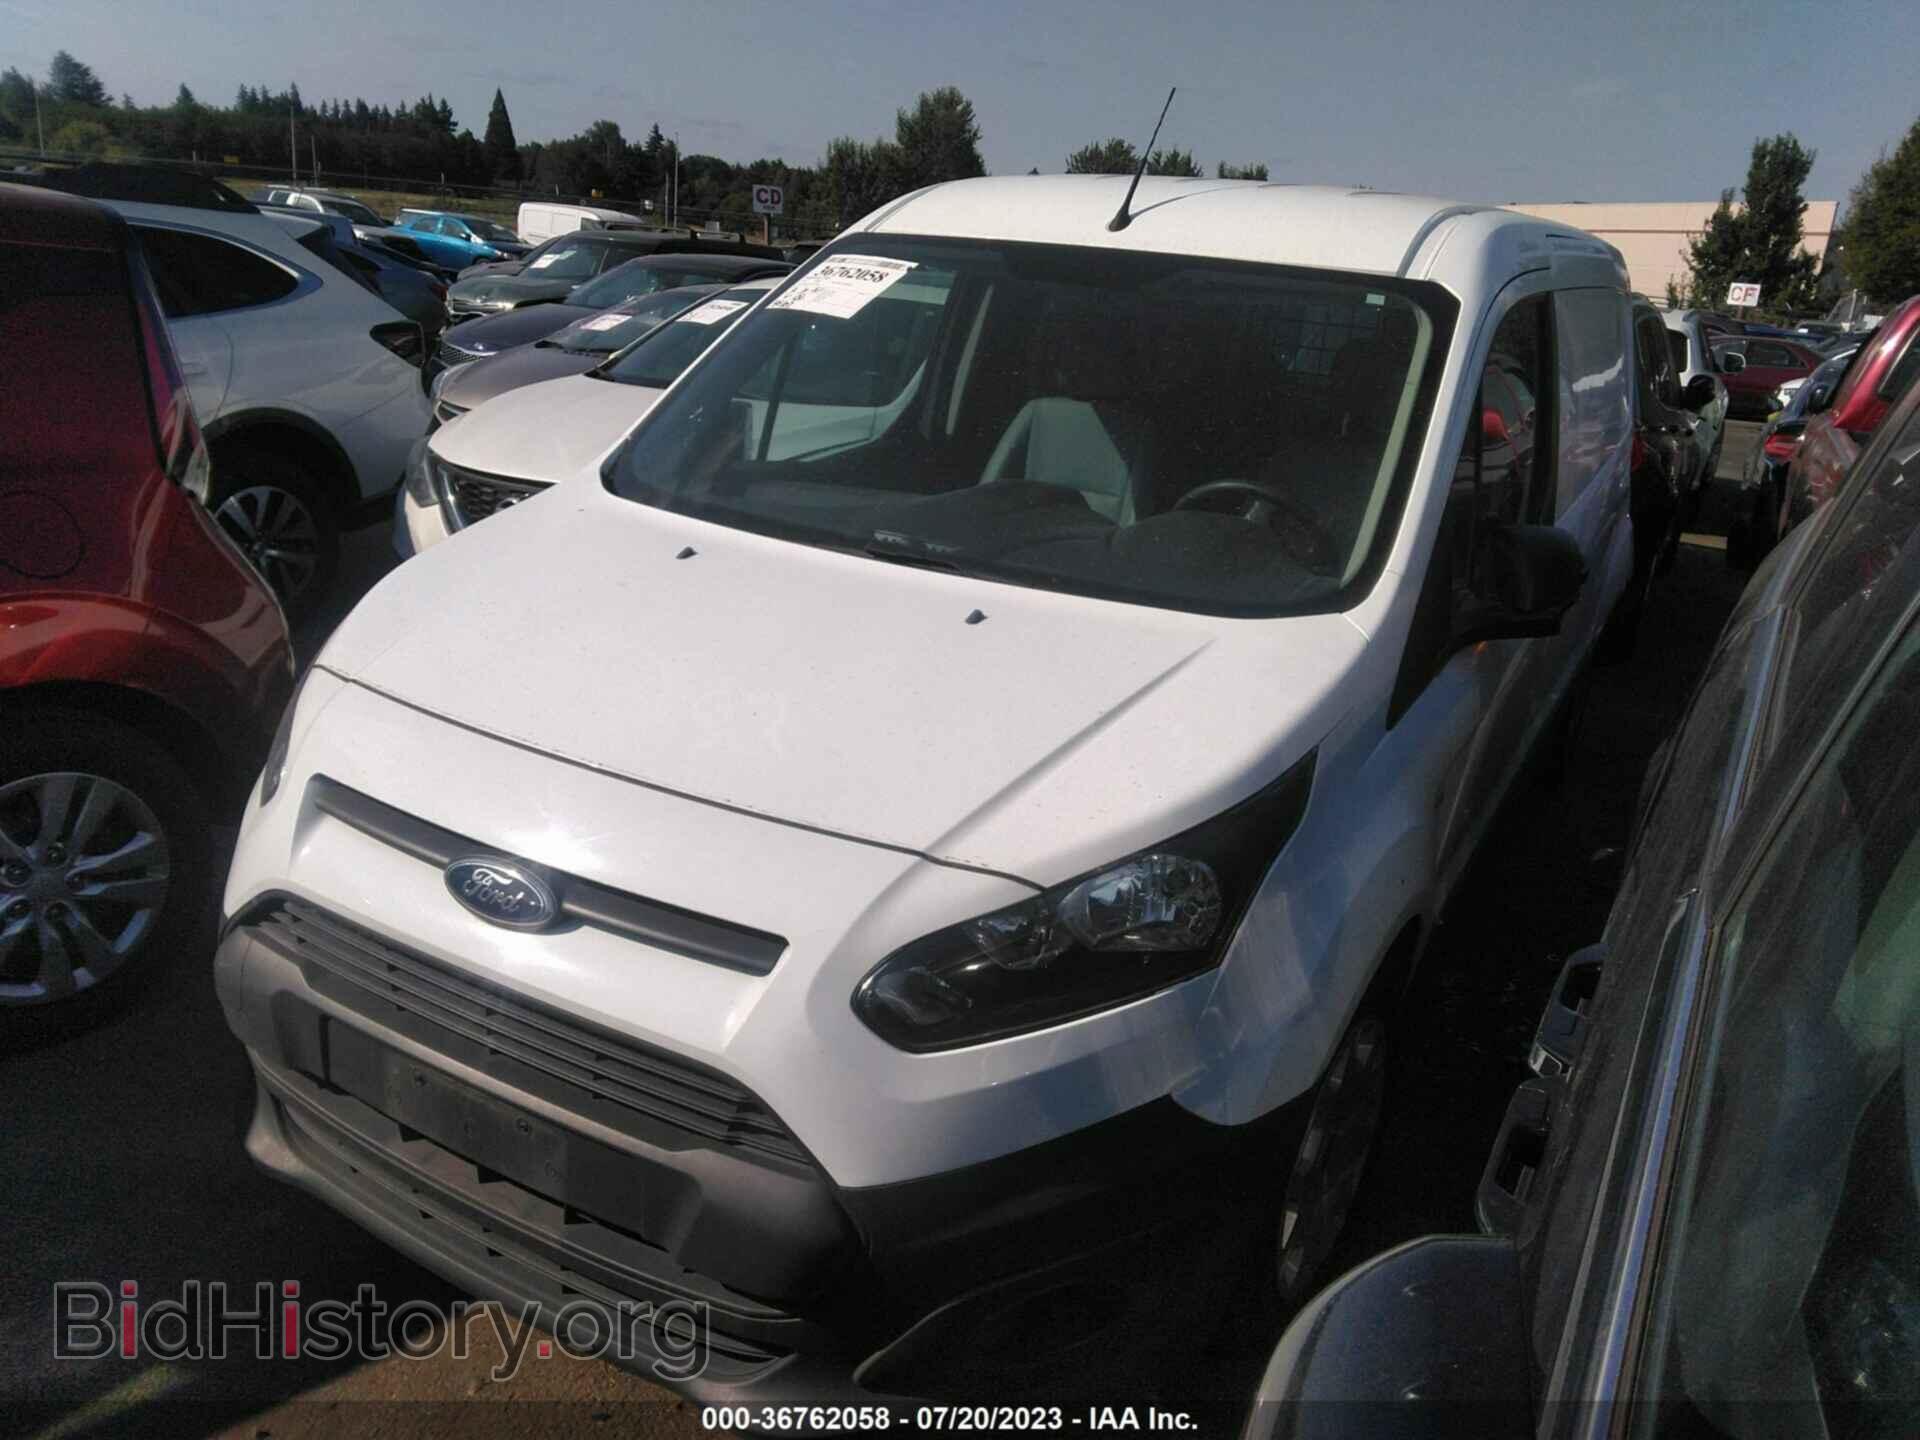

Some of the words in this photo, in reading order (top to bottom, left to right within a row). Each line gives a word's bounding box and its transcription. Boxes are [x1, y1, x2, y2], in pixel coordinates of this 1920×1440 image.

[756, 188, 781, 204] CD
[1731, 286, 1757, 301] CF
[463, 868, 525, 912] Ford
